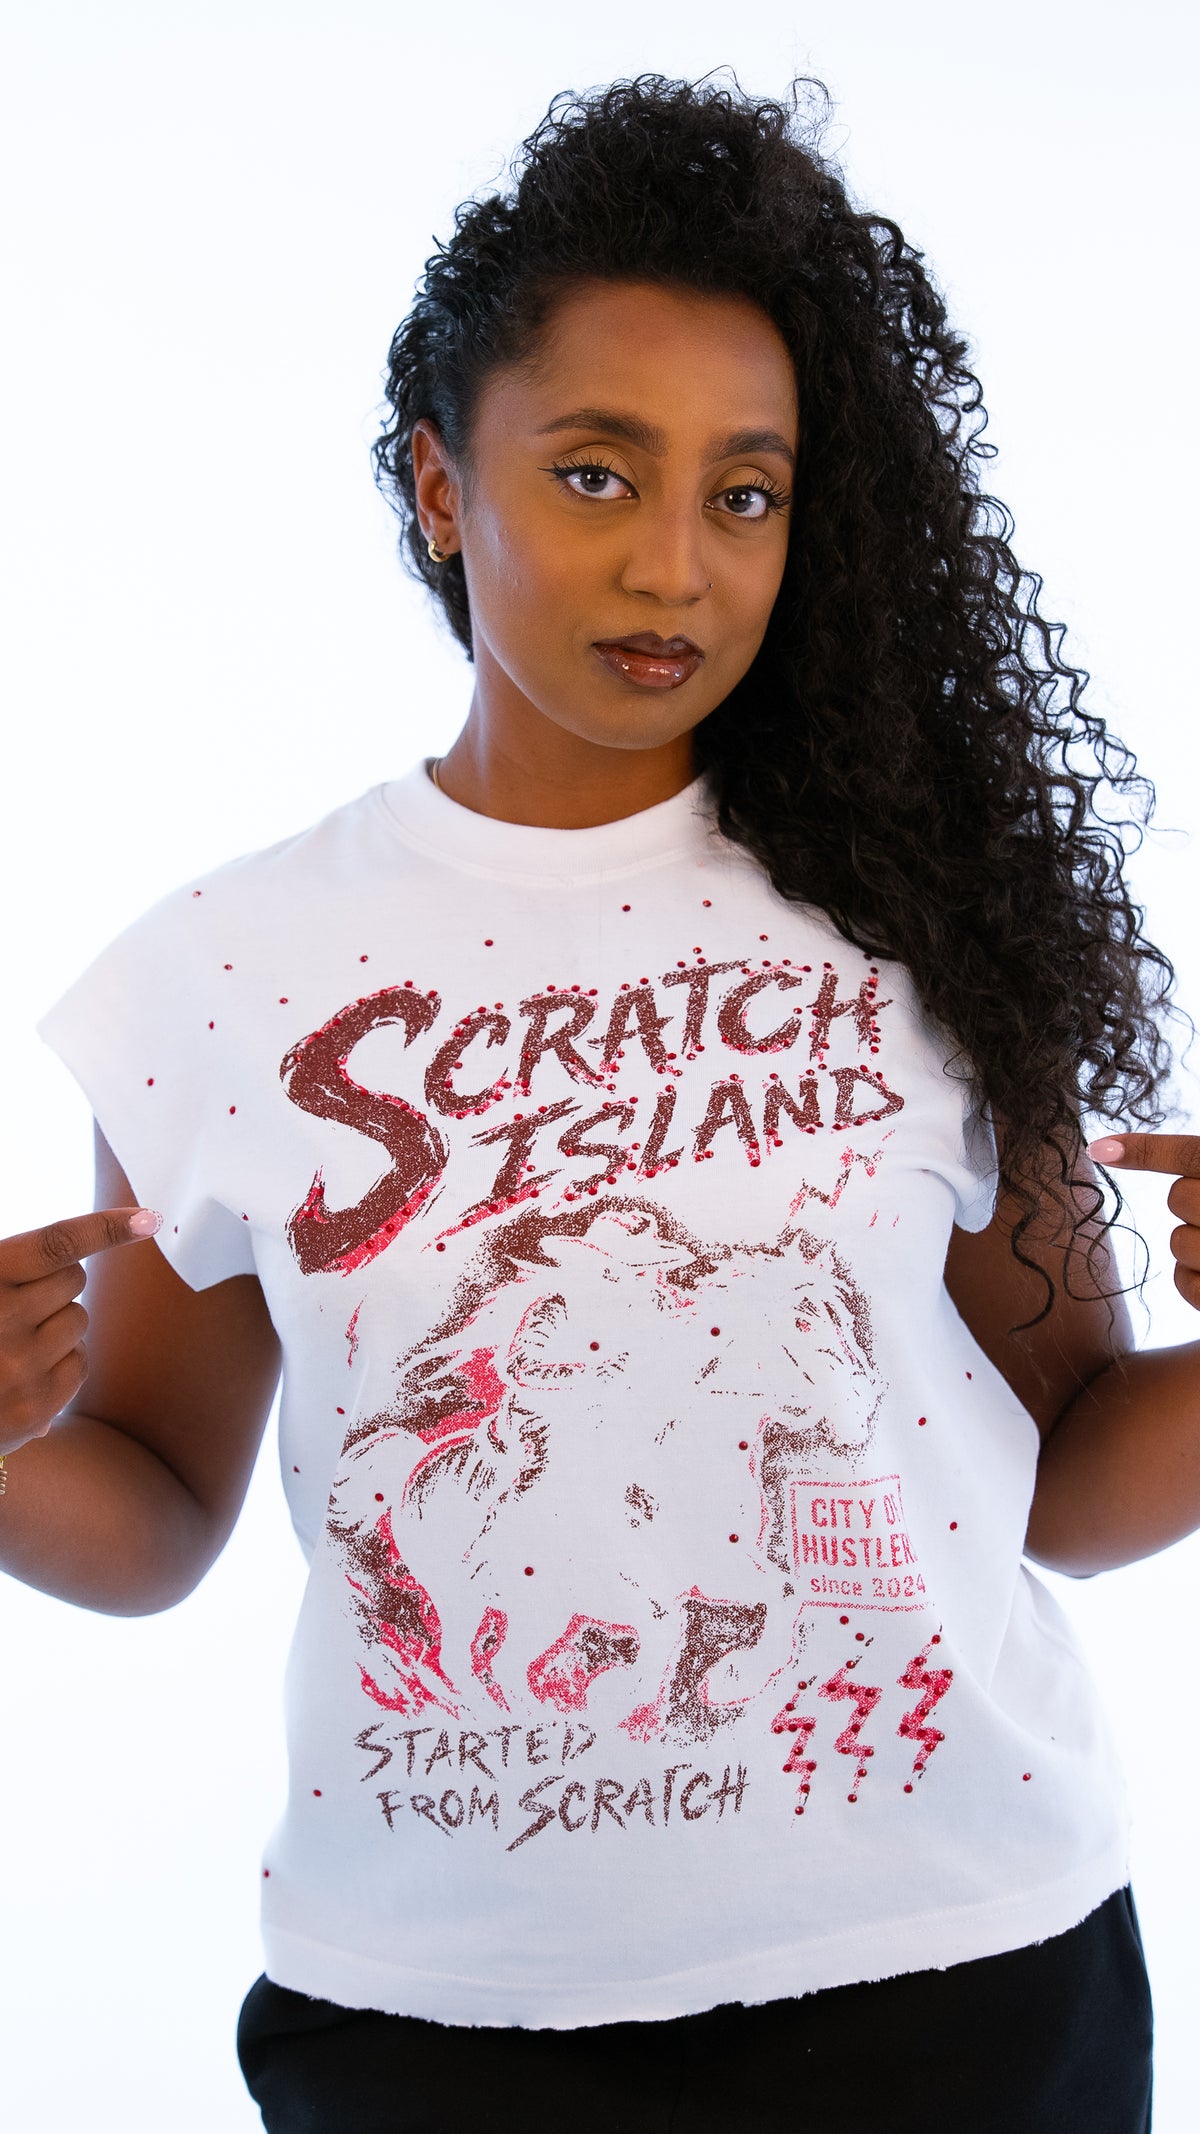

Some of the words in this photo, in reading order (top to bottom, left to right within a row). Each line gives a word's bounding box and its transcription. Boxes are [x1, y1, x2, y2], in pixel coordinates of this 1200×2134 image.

[281, 957, 893, 1277] SCRATCH
[438, 1065, 905, 1240] ISLAND
[811, 1498, 876, 1528] CITY
[809, 1574, 862, 1597] since
[872, 1573, 926, 1598] 2024
[353, 1721, 597, 1782] STARTED
[376, 1785, 500, 1838] FROM
[505, 1761, 750, 1853] SCRATCH
